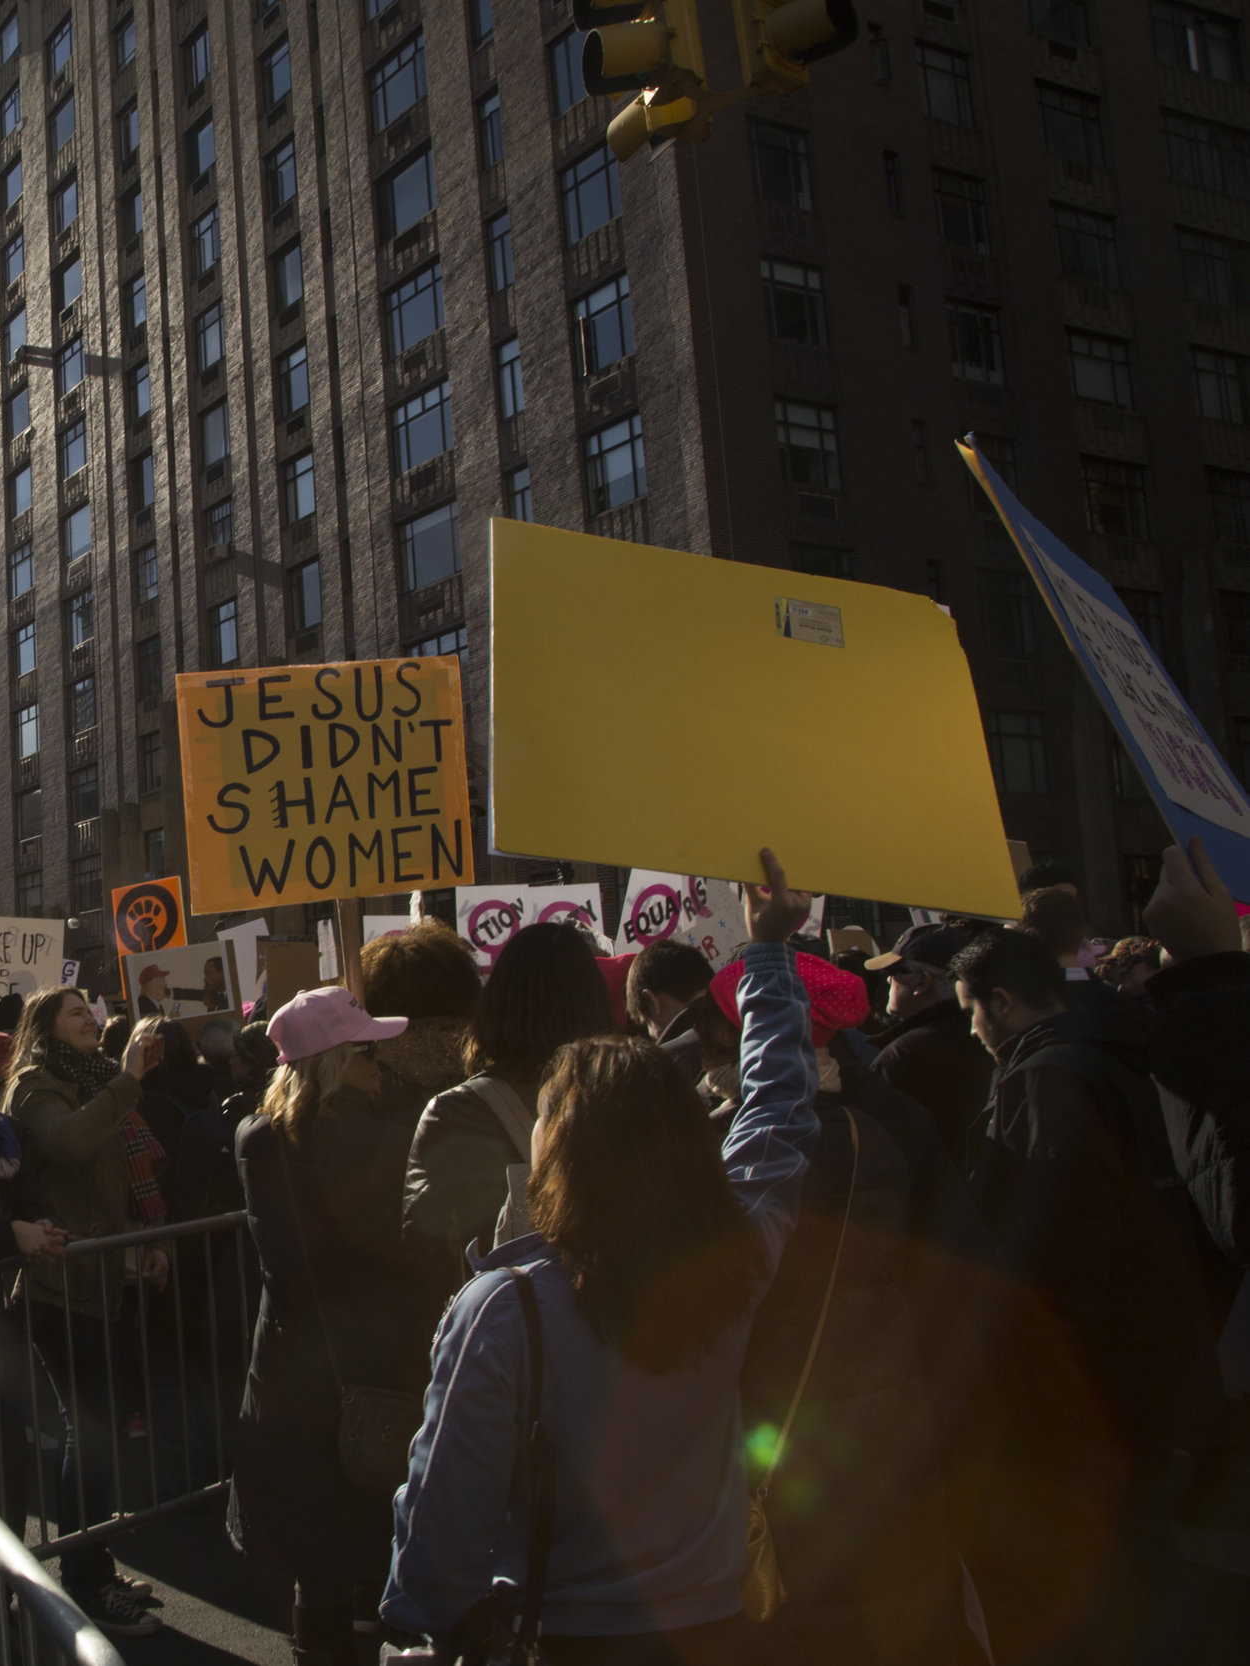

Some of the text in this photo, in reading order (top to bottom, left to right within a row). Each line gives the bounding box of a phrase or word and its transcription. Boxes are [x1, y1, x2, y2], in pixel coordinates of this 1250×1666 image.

[197, 661, 421, 728] JESUS
[242, 718, 453, 774] DIDN'T
[207, 766, 441, 834] SHAME
[239, 819, 463, 897] WOMEN
[462, 897, 525, 951] CTION
[624, 889, 682, 943] EQUA
[22, 933, 46, 965] UP
